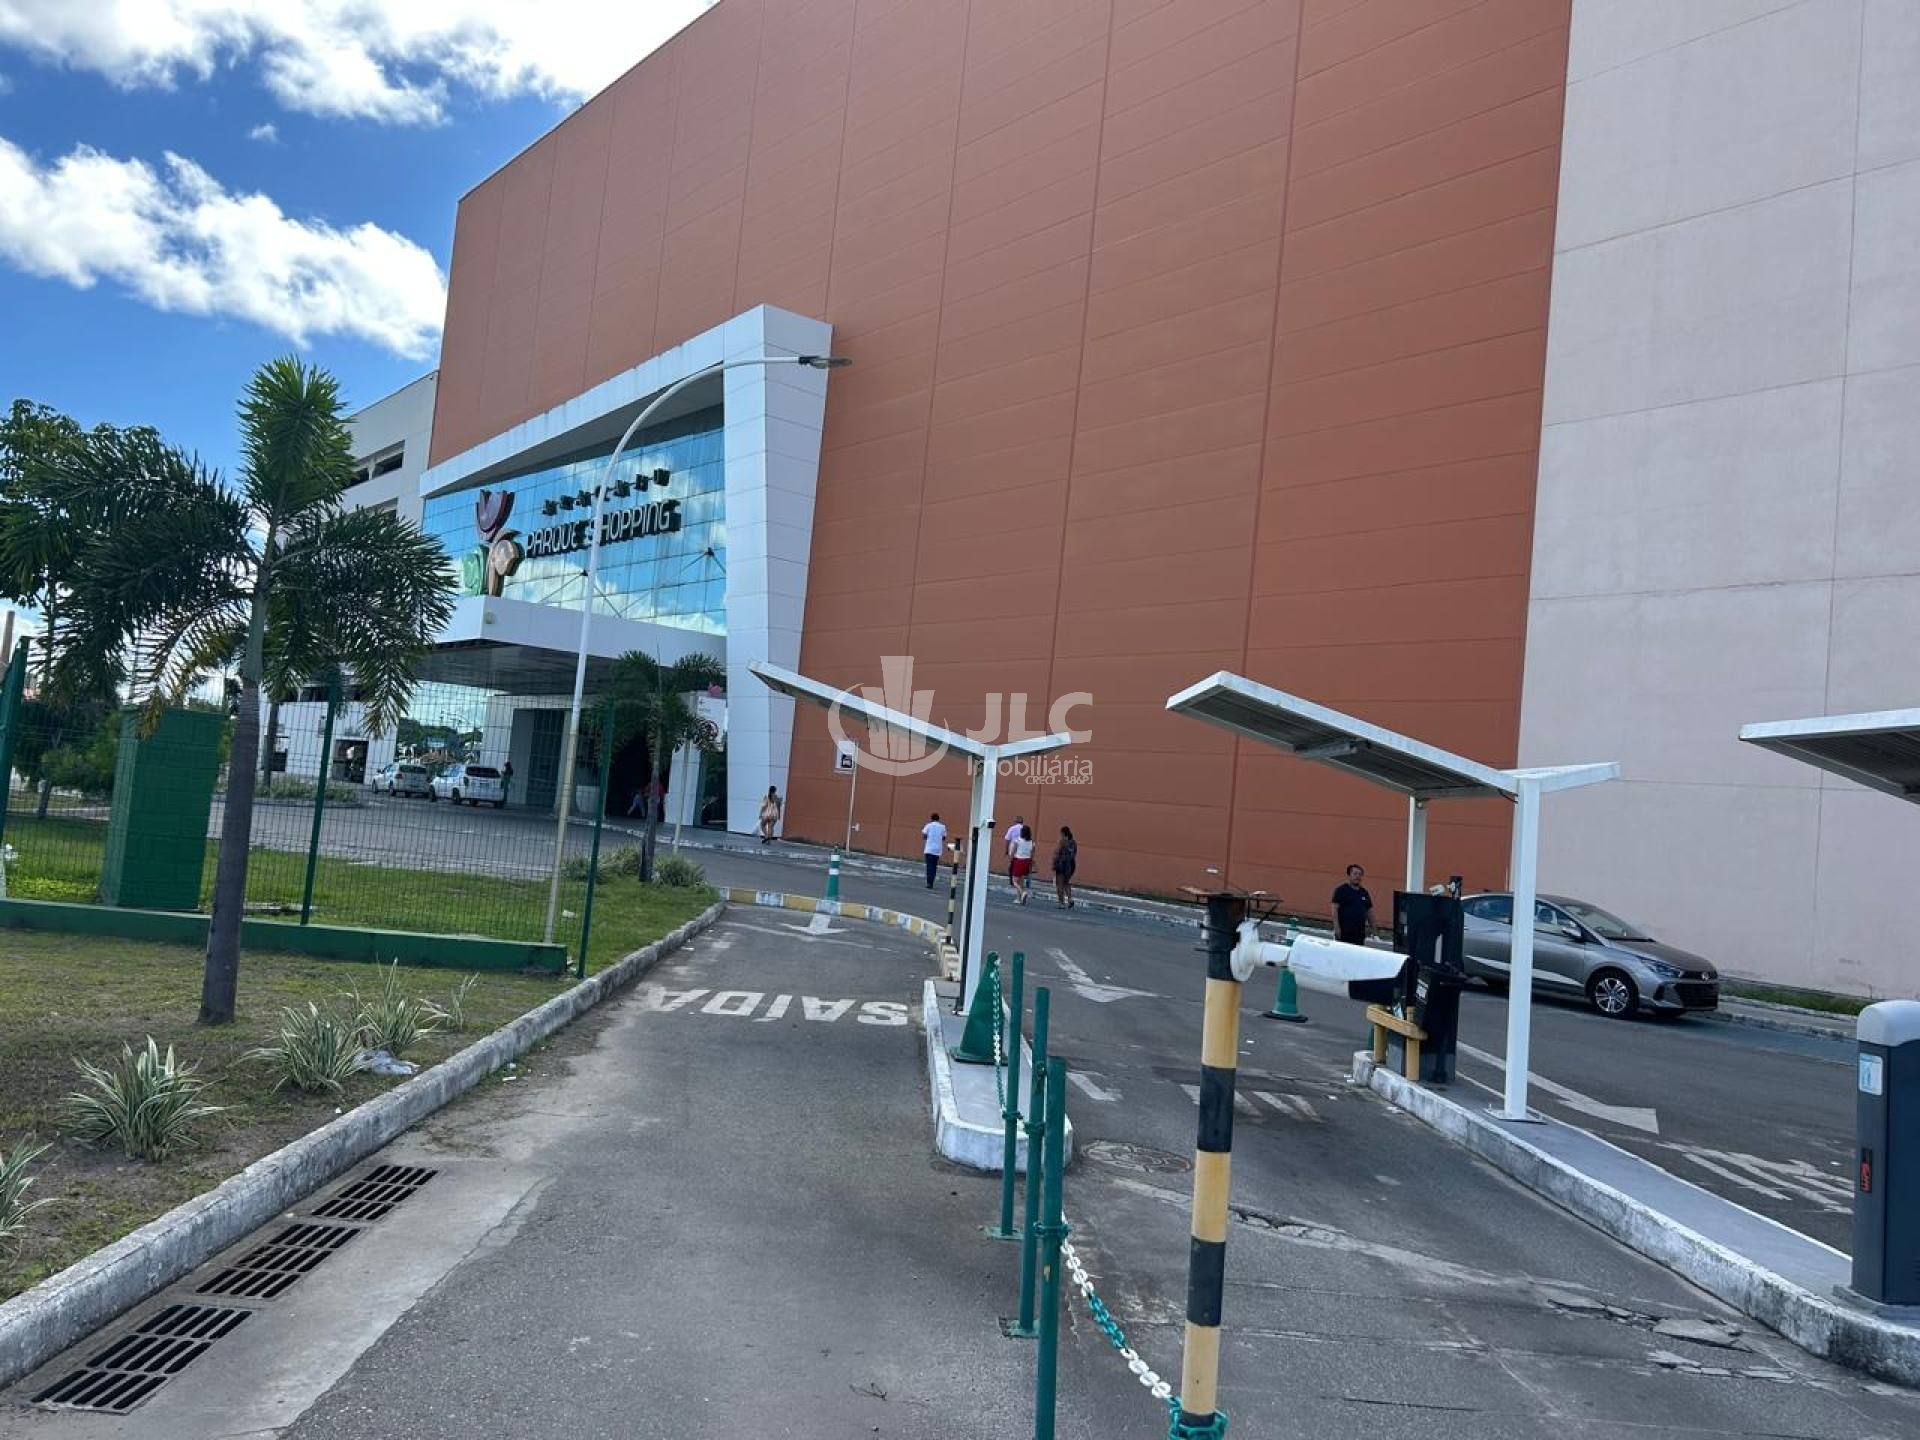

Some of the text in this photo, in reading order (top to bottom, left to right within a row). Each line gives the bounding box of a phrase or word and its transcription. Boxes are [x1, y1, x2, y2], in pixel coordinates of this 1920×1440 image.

[526, 500, 681, 556] PARQUE SHOPPING
[648, 988, 909, 1026] SAÍDA
